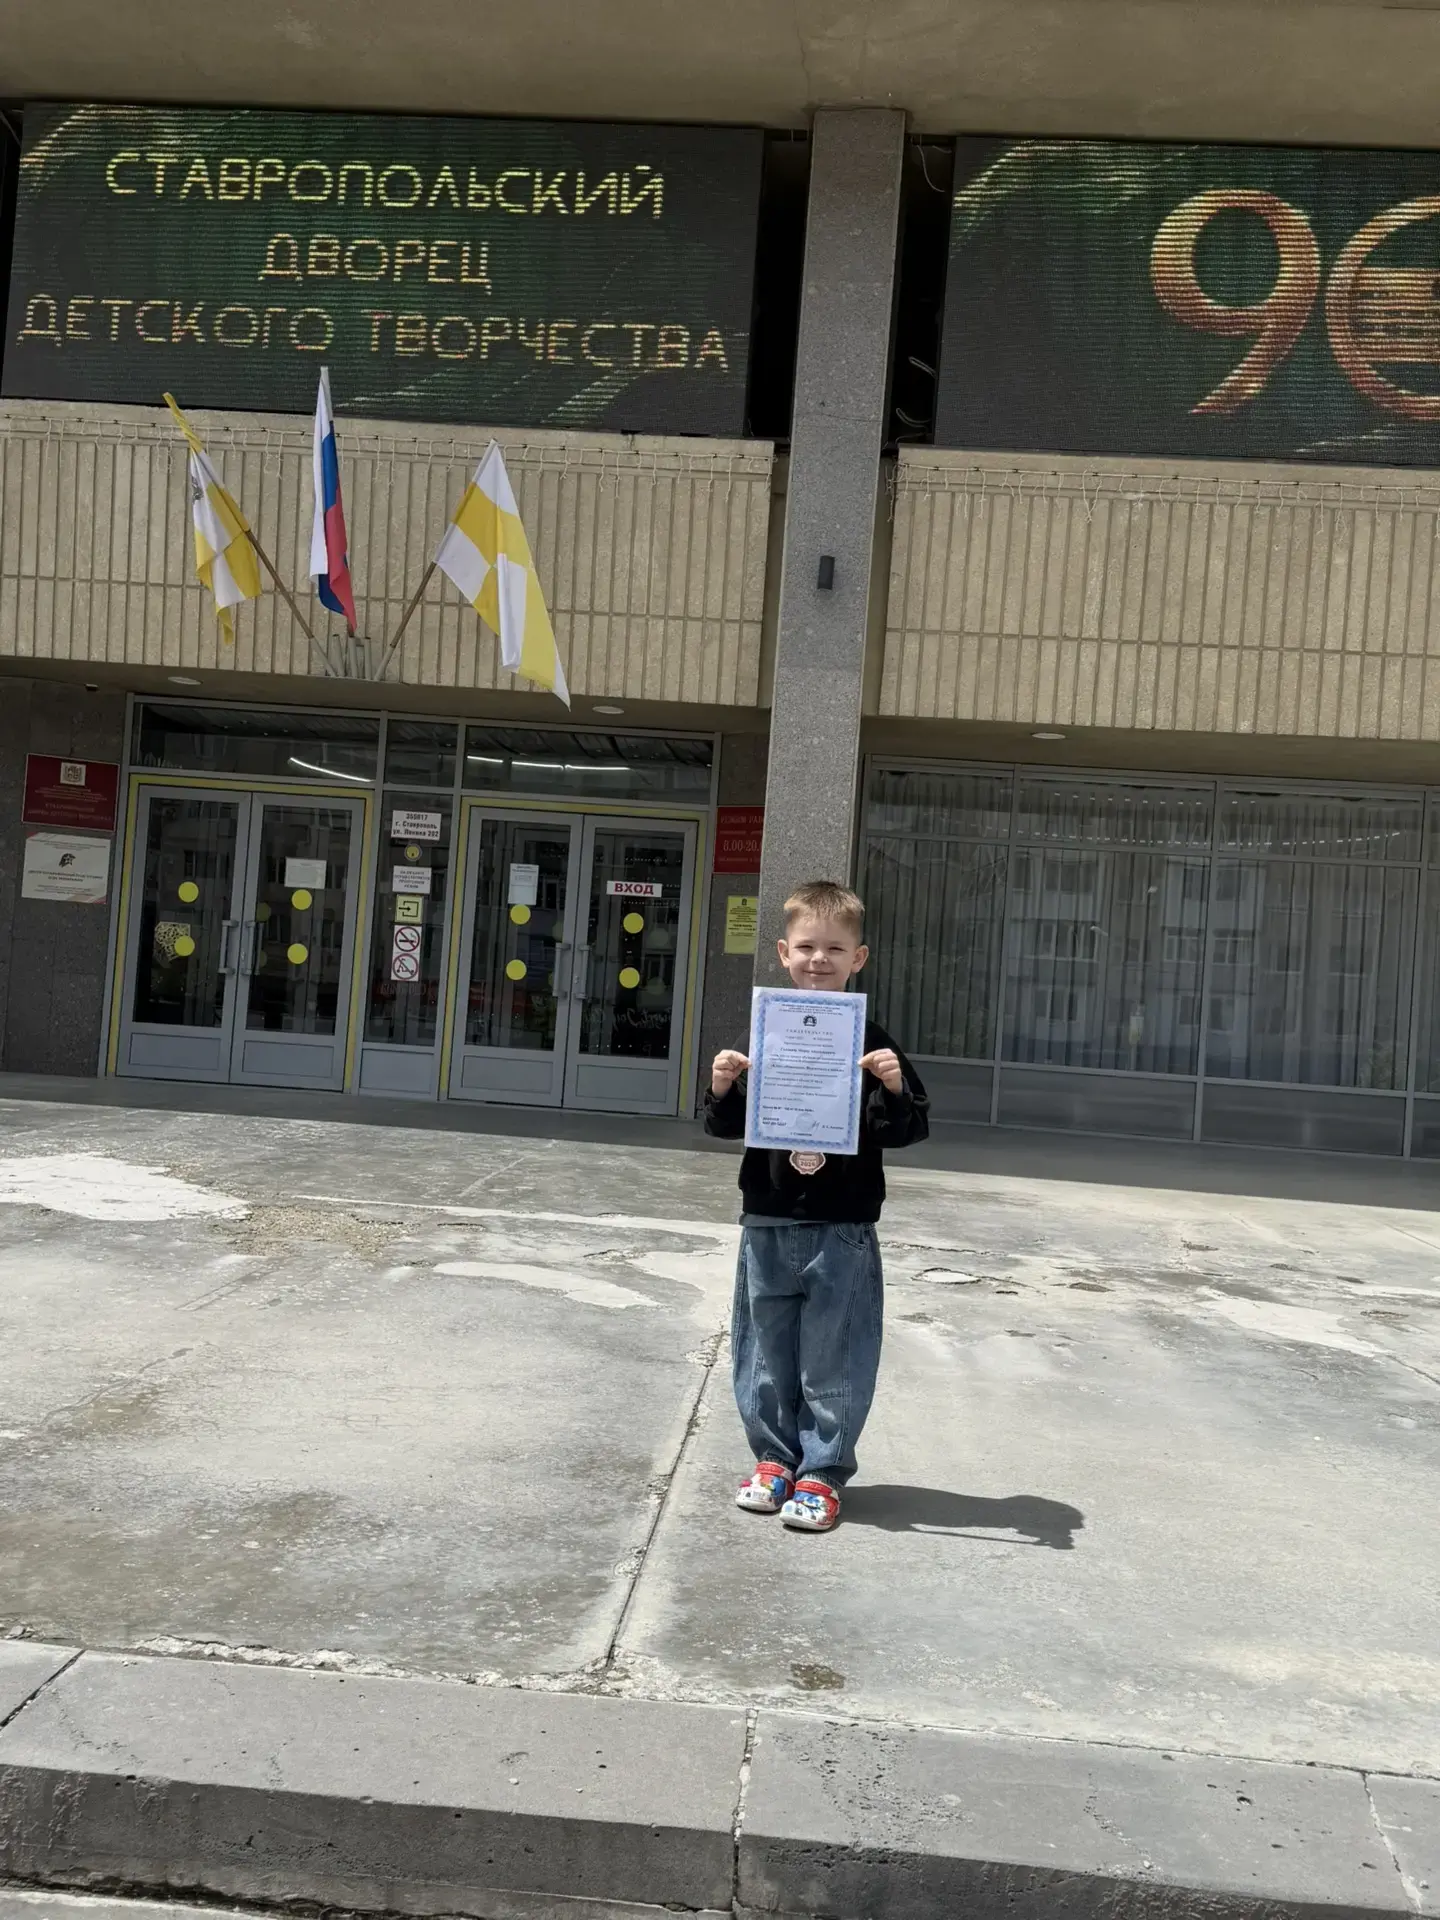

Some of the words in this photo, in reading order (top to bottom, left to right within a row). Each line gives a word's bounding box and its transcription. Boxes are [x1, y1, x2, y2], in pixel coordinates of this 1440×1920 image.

[106, 151, 665, 219] СТАВРОПОЛЬСКИЙ
[258, 233, 492, 295] ДВОРЕЦ
[16, 294, 335, 352] ДЕТСКОГО
[368, 312, 730, 373] ТВОРЧЕСТВА
[402, 821, 438, 829] Ставрополь
[723, 839, 762, 852] 8.00-20.
[614, 882, 655, 895] ВХОД
